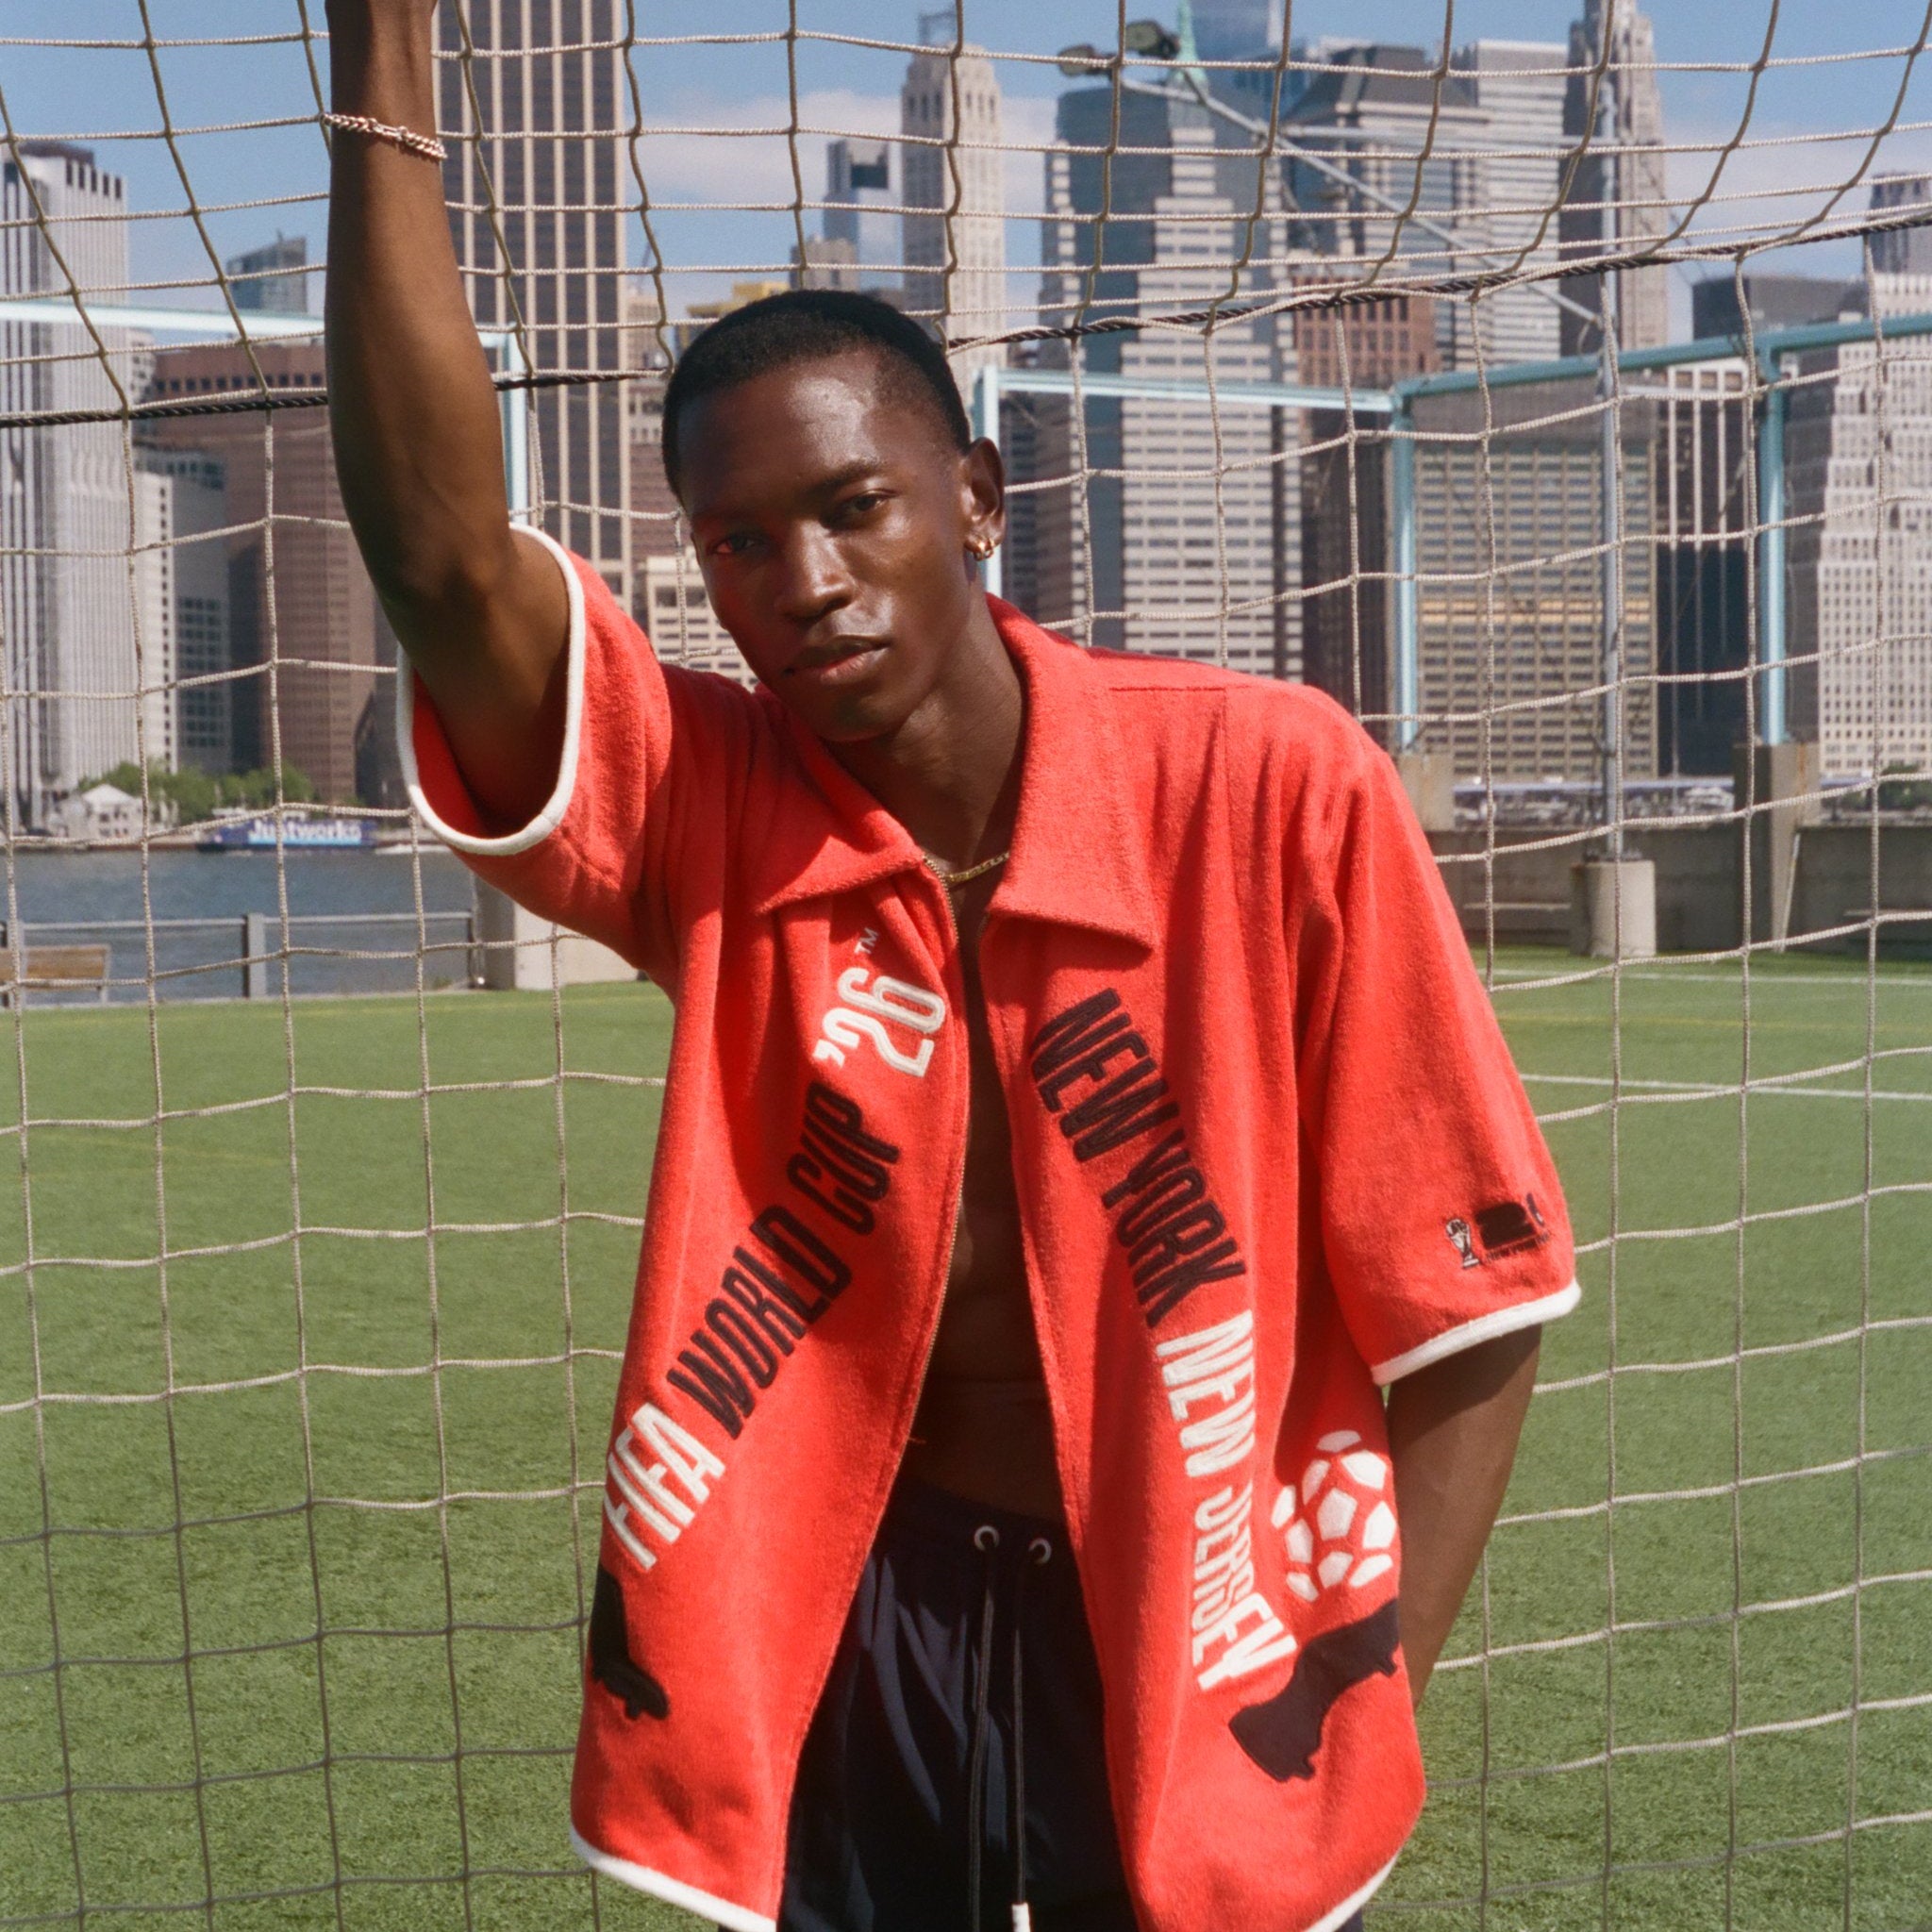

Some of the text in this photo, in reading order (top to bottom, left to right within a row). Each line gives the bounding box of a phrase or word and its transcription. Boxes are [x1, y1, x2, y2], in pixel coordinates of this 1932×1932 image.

[248, 819, 362, 841] Jutworks
[604, 1402, 726, 1571] FIFA
[666, 1204, 852, 1441] WORLD
[786, 1080, 900, 1236] CUP
[1030, 987, 1298, 1690] NEW YORK NEW JERSEY
